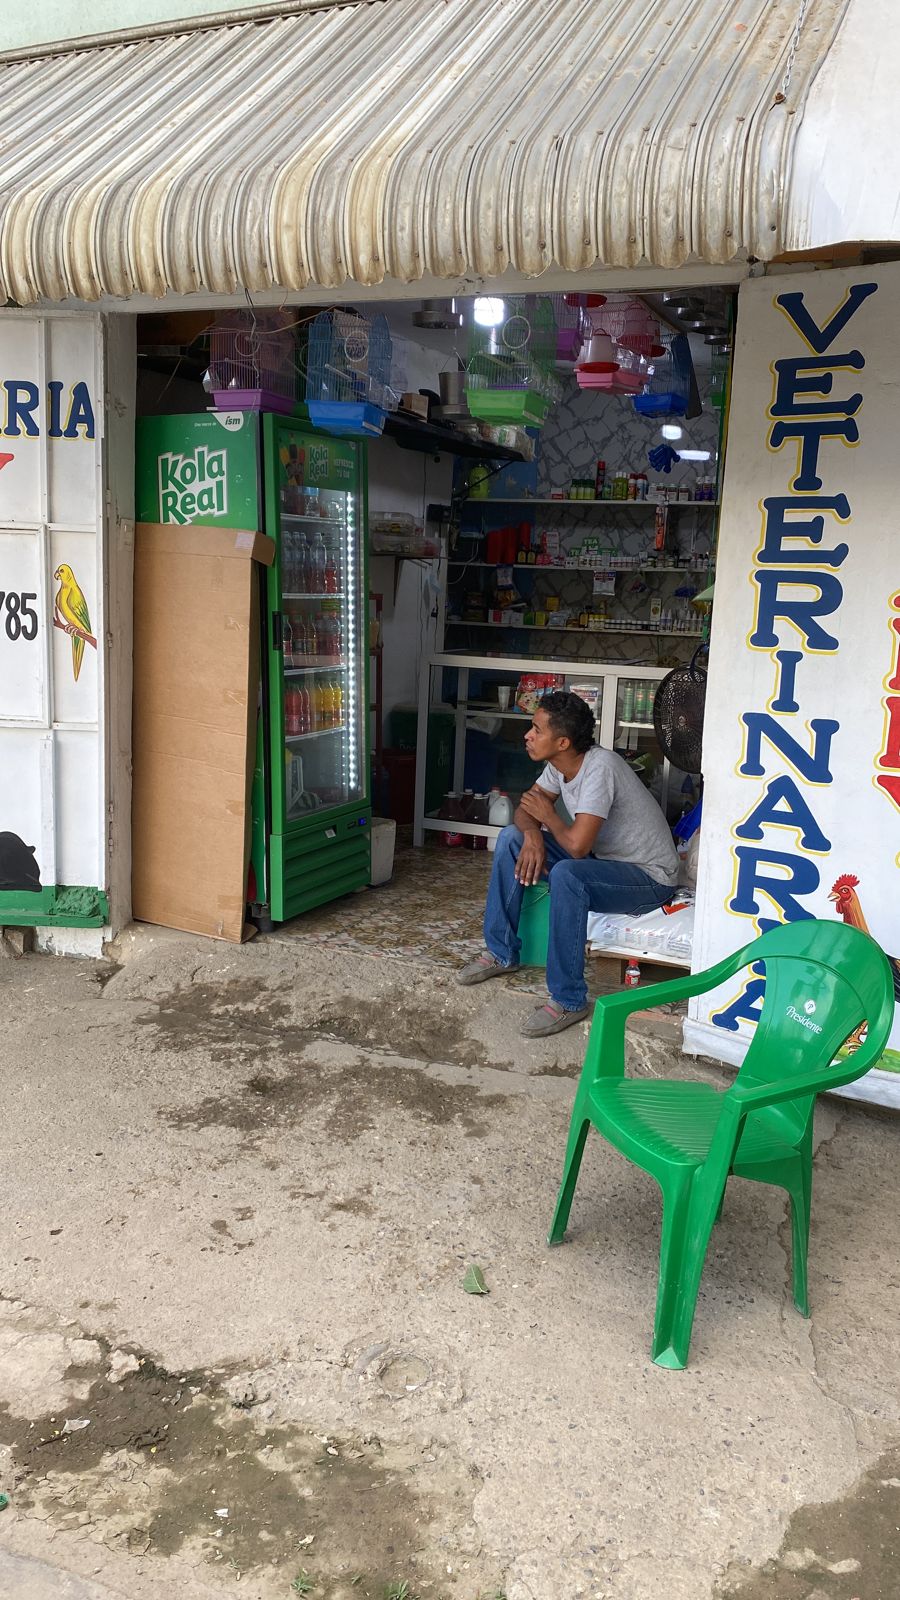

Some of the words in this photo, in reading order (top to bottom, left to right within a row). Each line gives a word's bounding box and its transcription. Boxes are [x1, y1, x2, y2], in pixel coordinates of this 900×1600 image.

[0, 381, 95, 439] RIA
[158, 446, 226, 493] Kola
[309, 445, 328, 464] Kola
[309, 462, 328, 480] Real
[161, 486, 228, 525] Real
[786, 1005, 823, 1034] Presidente
